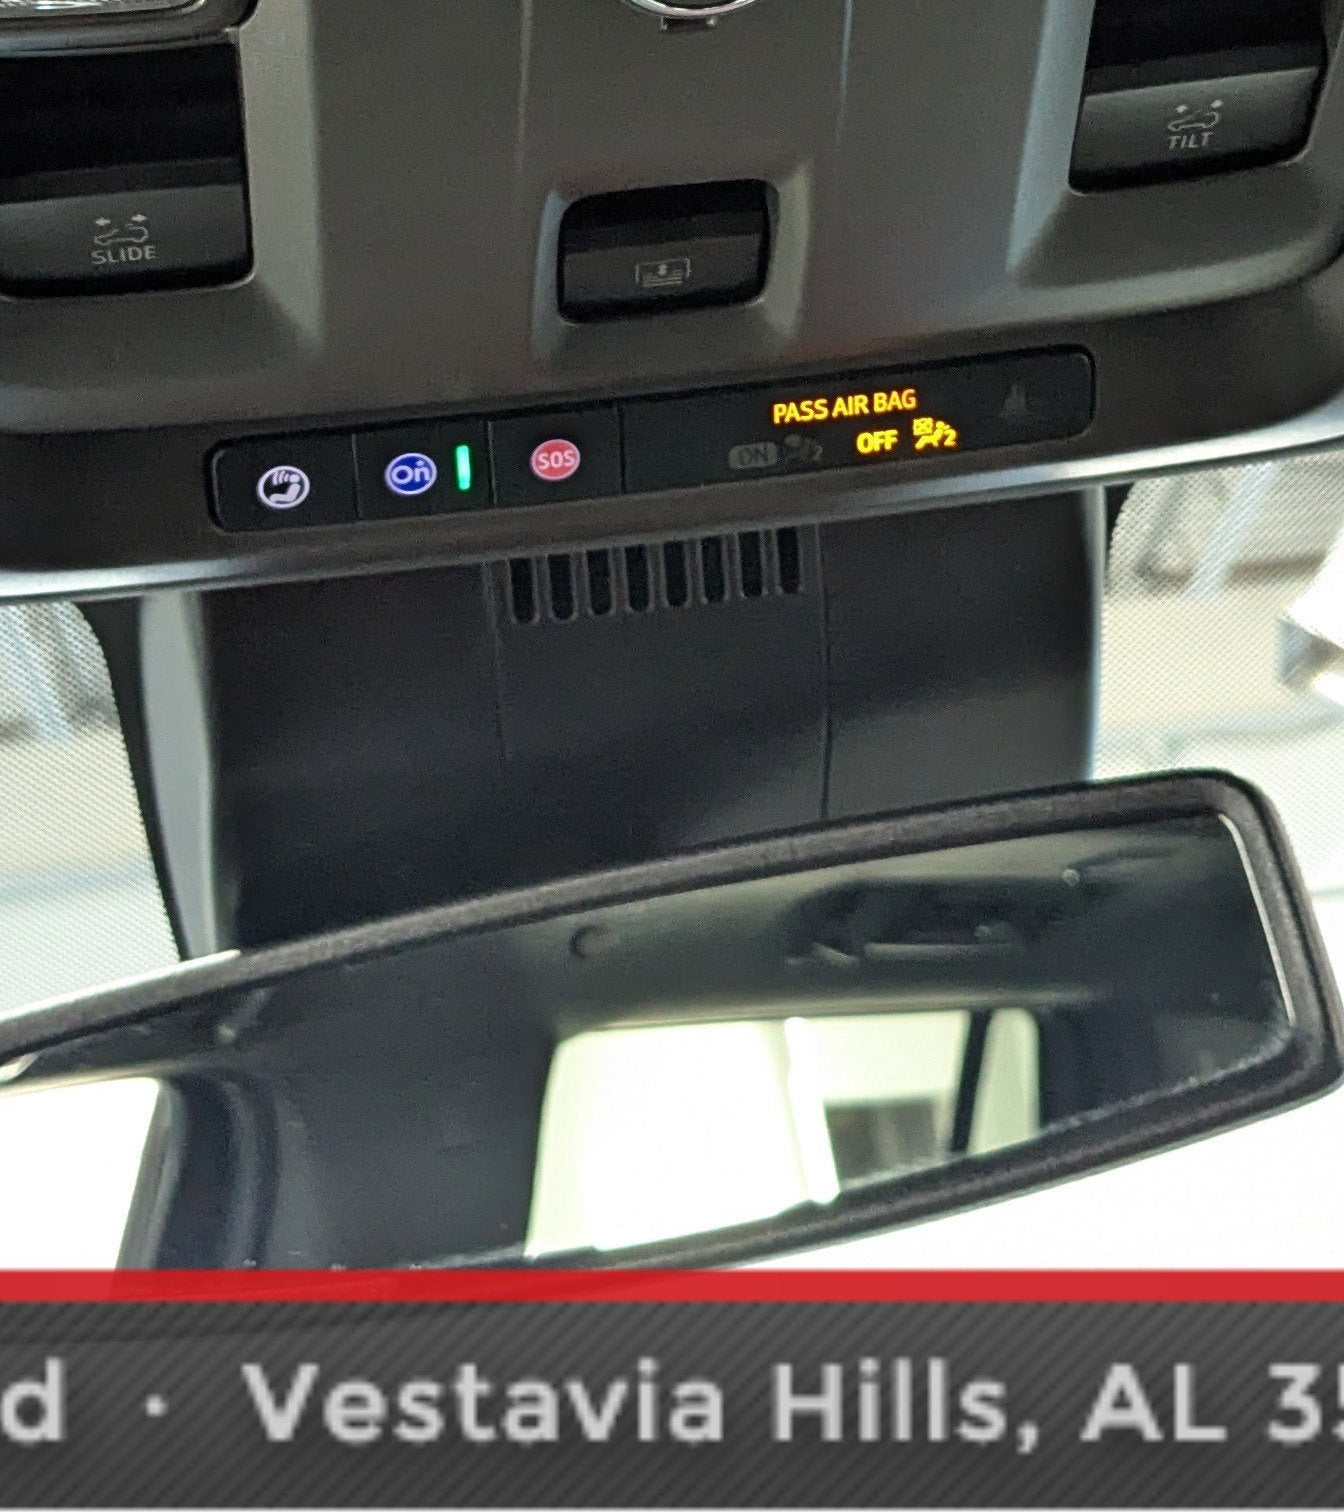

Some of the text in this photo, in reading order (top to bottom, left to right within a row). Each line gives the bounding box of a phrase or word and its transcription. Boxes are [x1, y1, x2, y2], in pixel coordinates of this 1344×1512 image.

[1168, 132, 1213, 150] TILT
[91, 244, 156, 265] SLIDE
[772, 388, 917, 425] PASS AIR BAG
[855, 429, 898, 455] OFF
[535, 448, 576, 470] SOS
